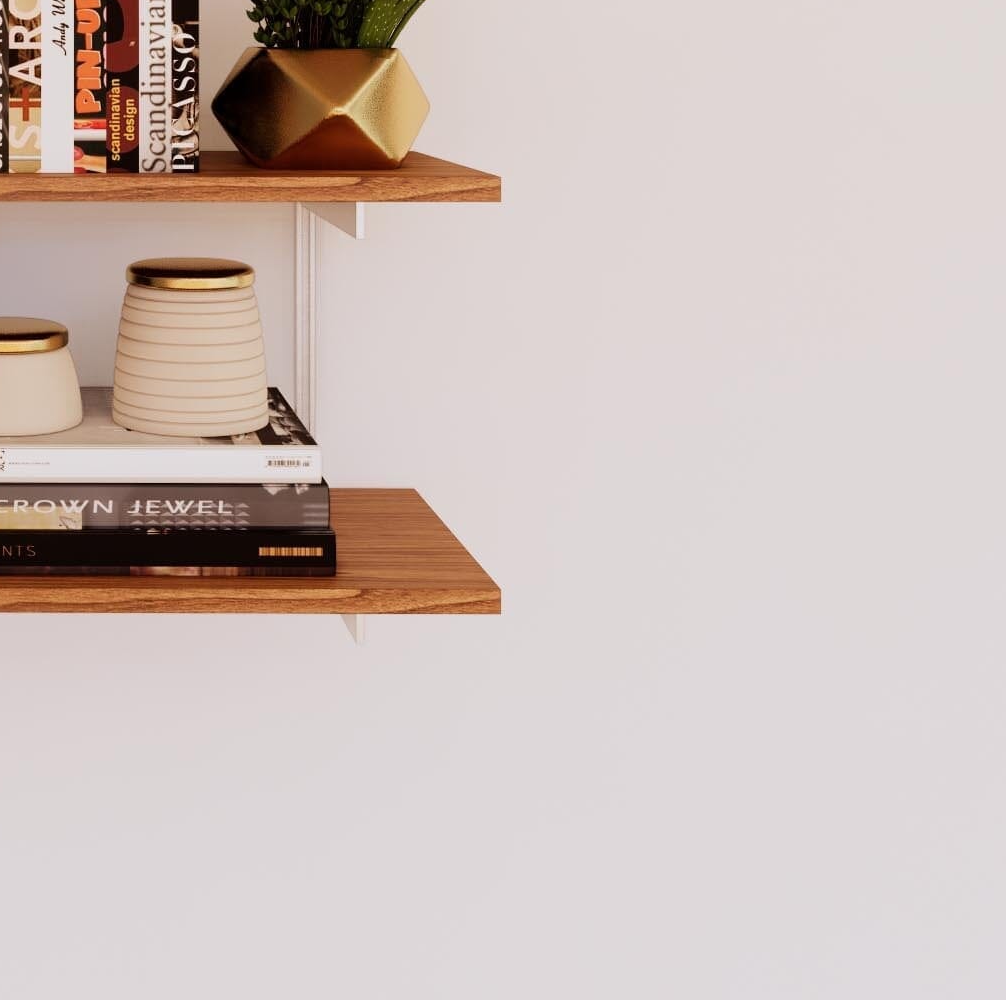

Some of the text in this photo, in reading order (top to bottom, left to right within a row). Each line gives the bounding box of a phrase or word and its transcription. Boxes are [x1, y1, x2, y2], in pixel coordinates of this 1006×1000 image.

[52, 23, 69, 56] Andy
[111, 78, 121, 161] scandinavian
[123, 98, 137, 141] design
[172, 32, 196, 170] PICASSO
[126, 499, 234, 515] JEWEL
